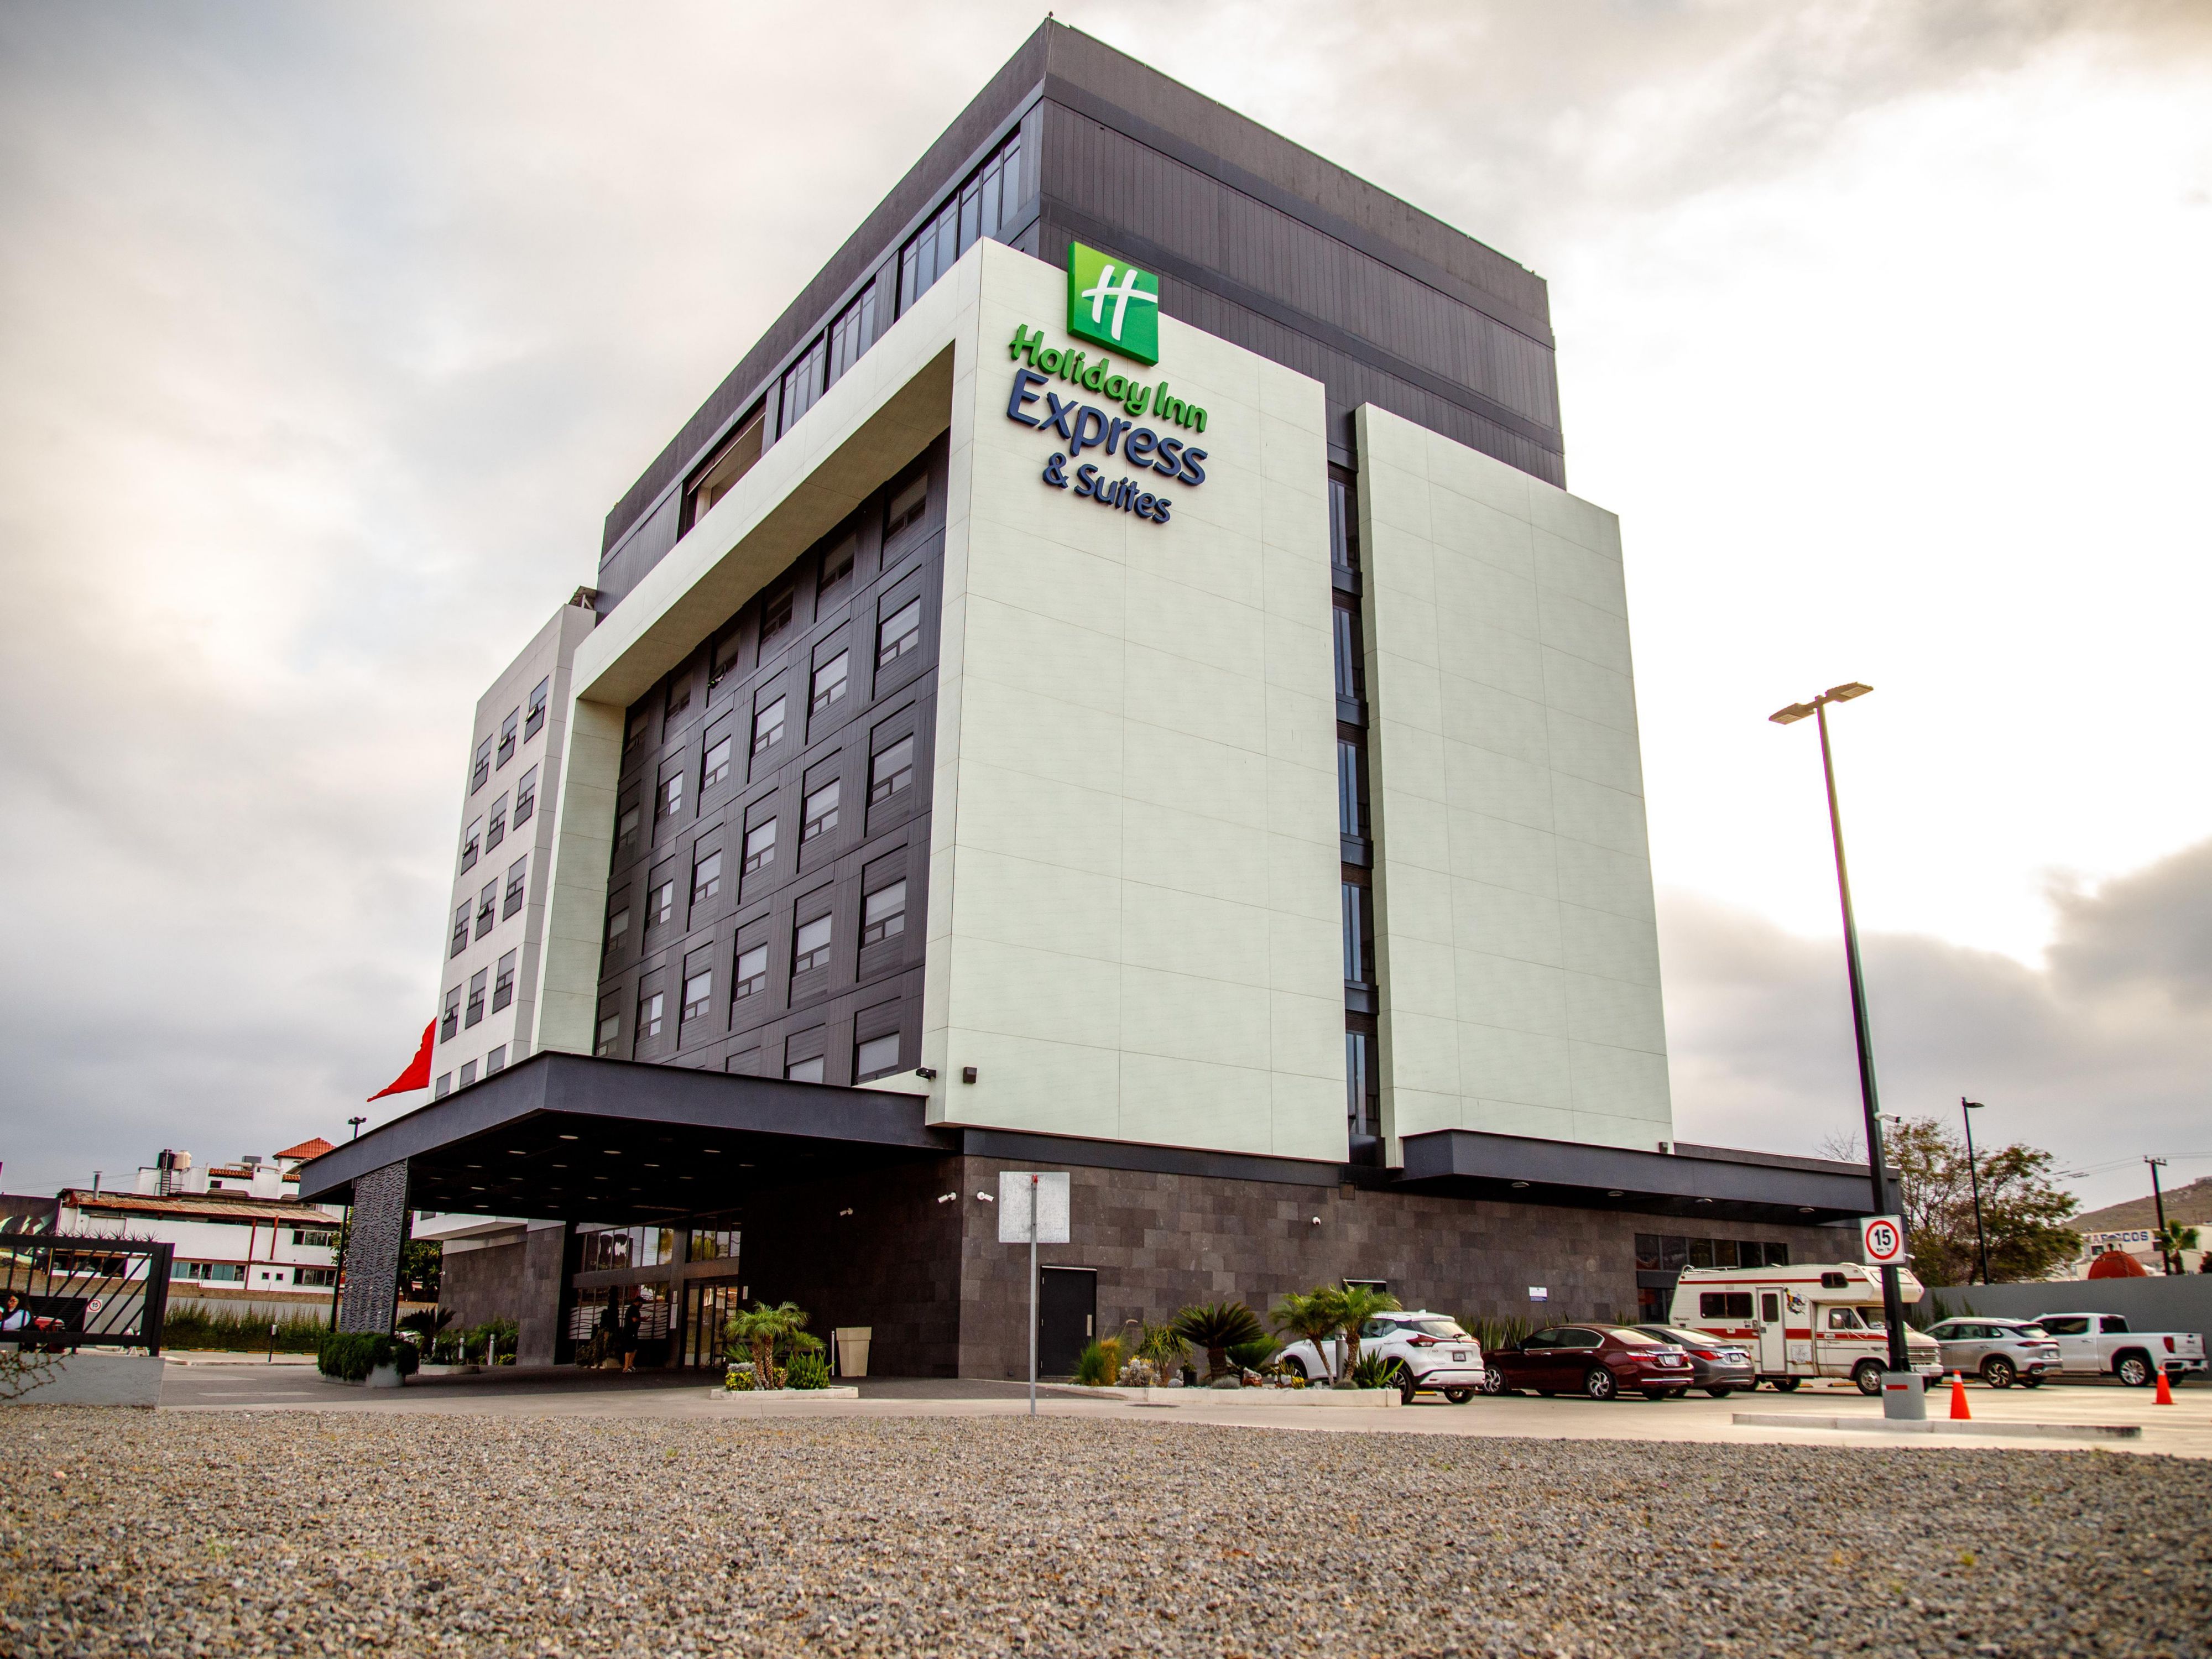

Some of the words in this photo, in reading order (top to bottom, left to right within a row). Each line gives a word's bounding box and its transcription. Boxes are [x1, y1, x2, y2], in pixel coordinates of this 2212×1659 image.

[1009, 324, 1151, 416] Holiday
[1154, 380, 1208, 433] Inn
[1006, 368, 1208, 486] Express
[1042, 452, 1069, 489] &
[1074, 463, 1172, 523] Suites
[1874, 1229, 1891, 1246] 15
